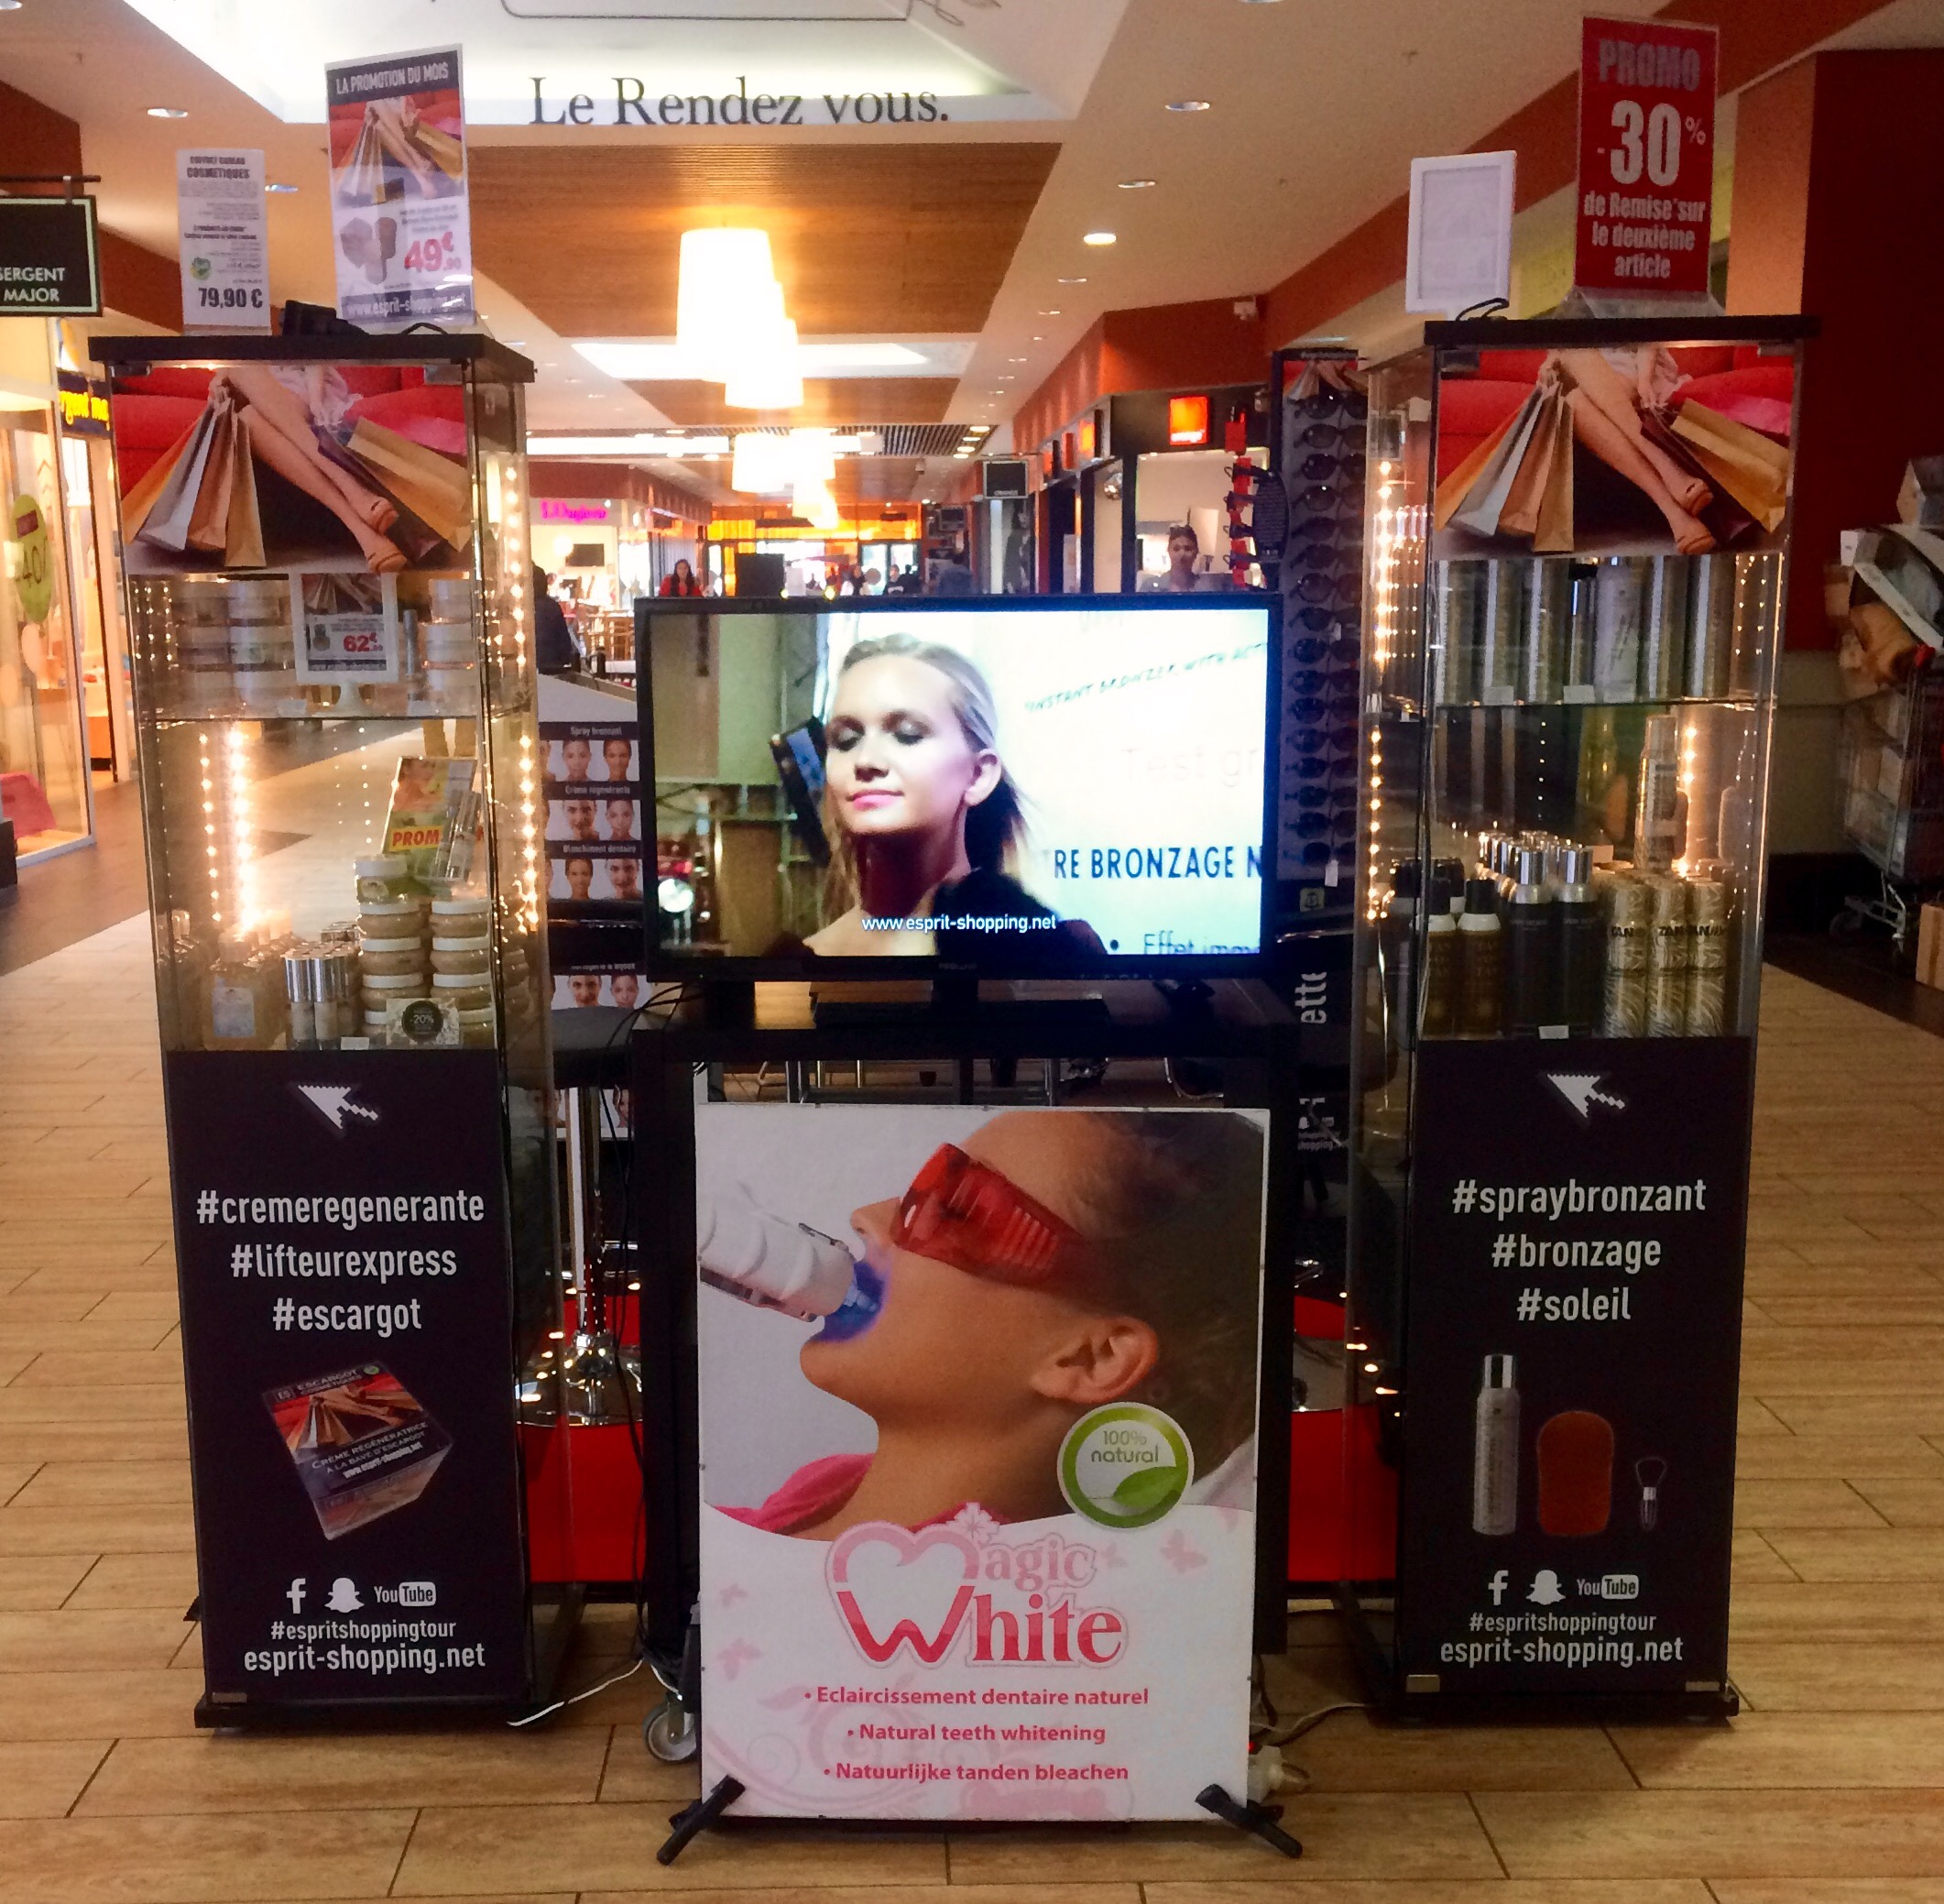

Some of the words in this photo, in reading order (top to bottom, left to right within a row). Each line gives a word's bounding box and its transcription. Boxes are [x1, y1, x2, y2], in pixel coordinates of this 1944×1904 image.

[335, 78, 349, 94] LA
[350, 69, 406, 93] PROMOTION
[408, 66, 420, 84] DU
[422, 61, 449, 82] MOIS
[1598, 38, 1700, 91] PROMO
[529, 76, 594, 125] Le
[611, 75, 803, 126] Rendez
[1584, 191, 1606, 216] de
[1677, 201, 1707, 223] sur
[1591, 221, 1609, 246] le
[1612, 222, 1696, 251] deuxième
[1614, 253, 1671, 279] article
[4, 288, 60, 302] MAJOR
[198, 287, 246, 308] 79,90
[392, 828, 441, 848] PROM
[1090, 846, 1235, 879] BRONZAGE
[197, 1189, 485, 1231] #cremeregenerante
[1452, 1178, 1707, 1221] #spraybronzant
[231, 1243, 457, 1284] #lifteurexpress
[1491, 1233, 1661, 1275] #bronzage
[273, 1297, 421, 1338] #escargot
[1516, 1286, 1631, 1321] #soleil
[1103, 1430, 1147, 1445] 100%
[1090, 1445, 1159, 1463] natural
[271, 1619, 456, 1643] #espritshoppingtour
[835, 1585, 1123, 1664] White
[1469, 1612, 1656, 1636] #espritshoppingtour
[244, 1643, 486, 1677] esprit-shopping.net
[1440, 1636, 1684, 1669] esprit-shopping.net
[817, 1687, 977, 1704] Eclaircissement
[982, 1688, 1069, 1705] dentaire
[1075, 1688, 1149, 1704] naturel
[860, 1724, 936, 1741] Natural
[942, 1724, 996, 1741] teeth
[1001, 1725, 1106, 1745] whitening
[836, 1763, 951, 1784] Natuurlijke
[956, 1765, 1030, 1780] tanden
[1035, 1764, 1129, 1780] bleachen
